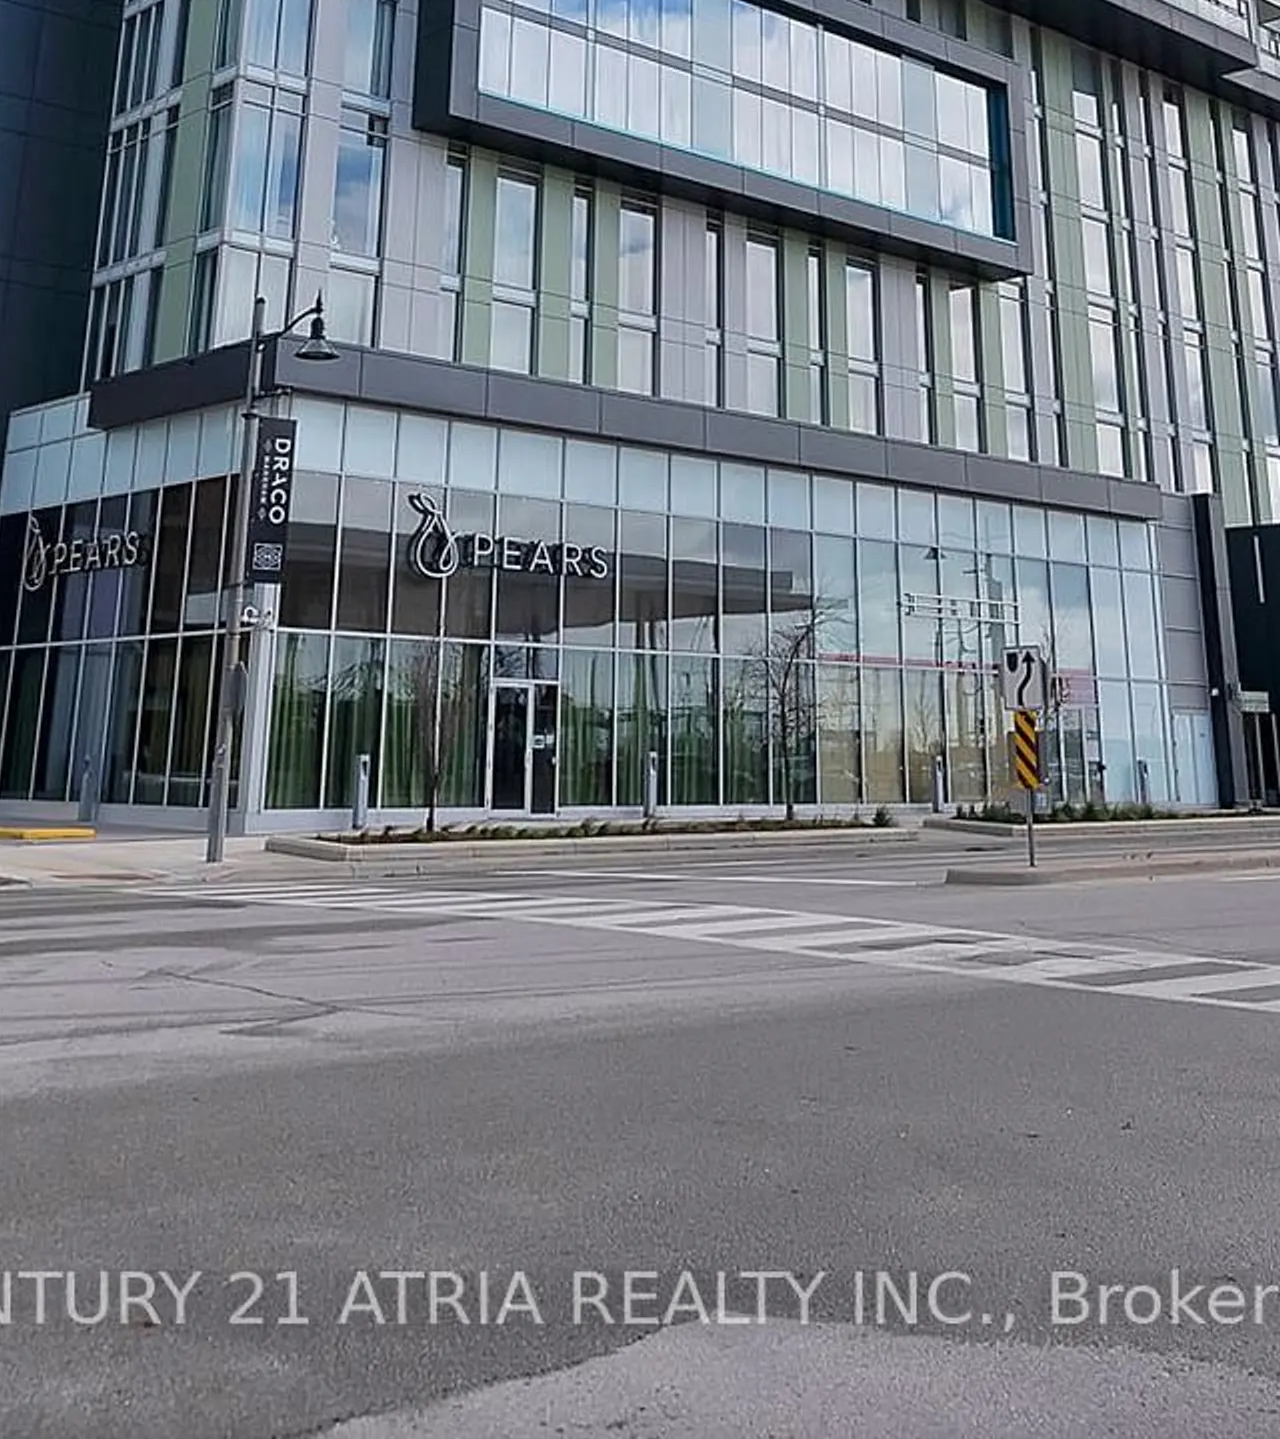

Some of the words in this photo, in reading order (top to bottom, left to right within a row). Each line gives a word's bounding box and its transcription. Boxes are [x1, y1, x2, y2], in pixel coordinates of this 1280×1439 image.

[269, 437, 292, 525] DRACO
[48, 530, 139, 575] PEARS
[473, 532, 609, 579] PEARS
